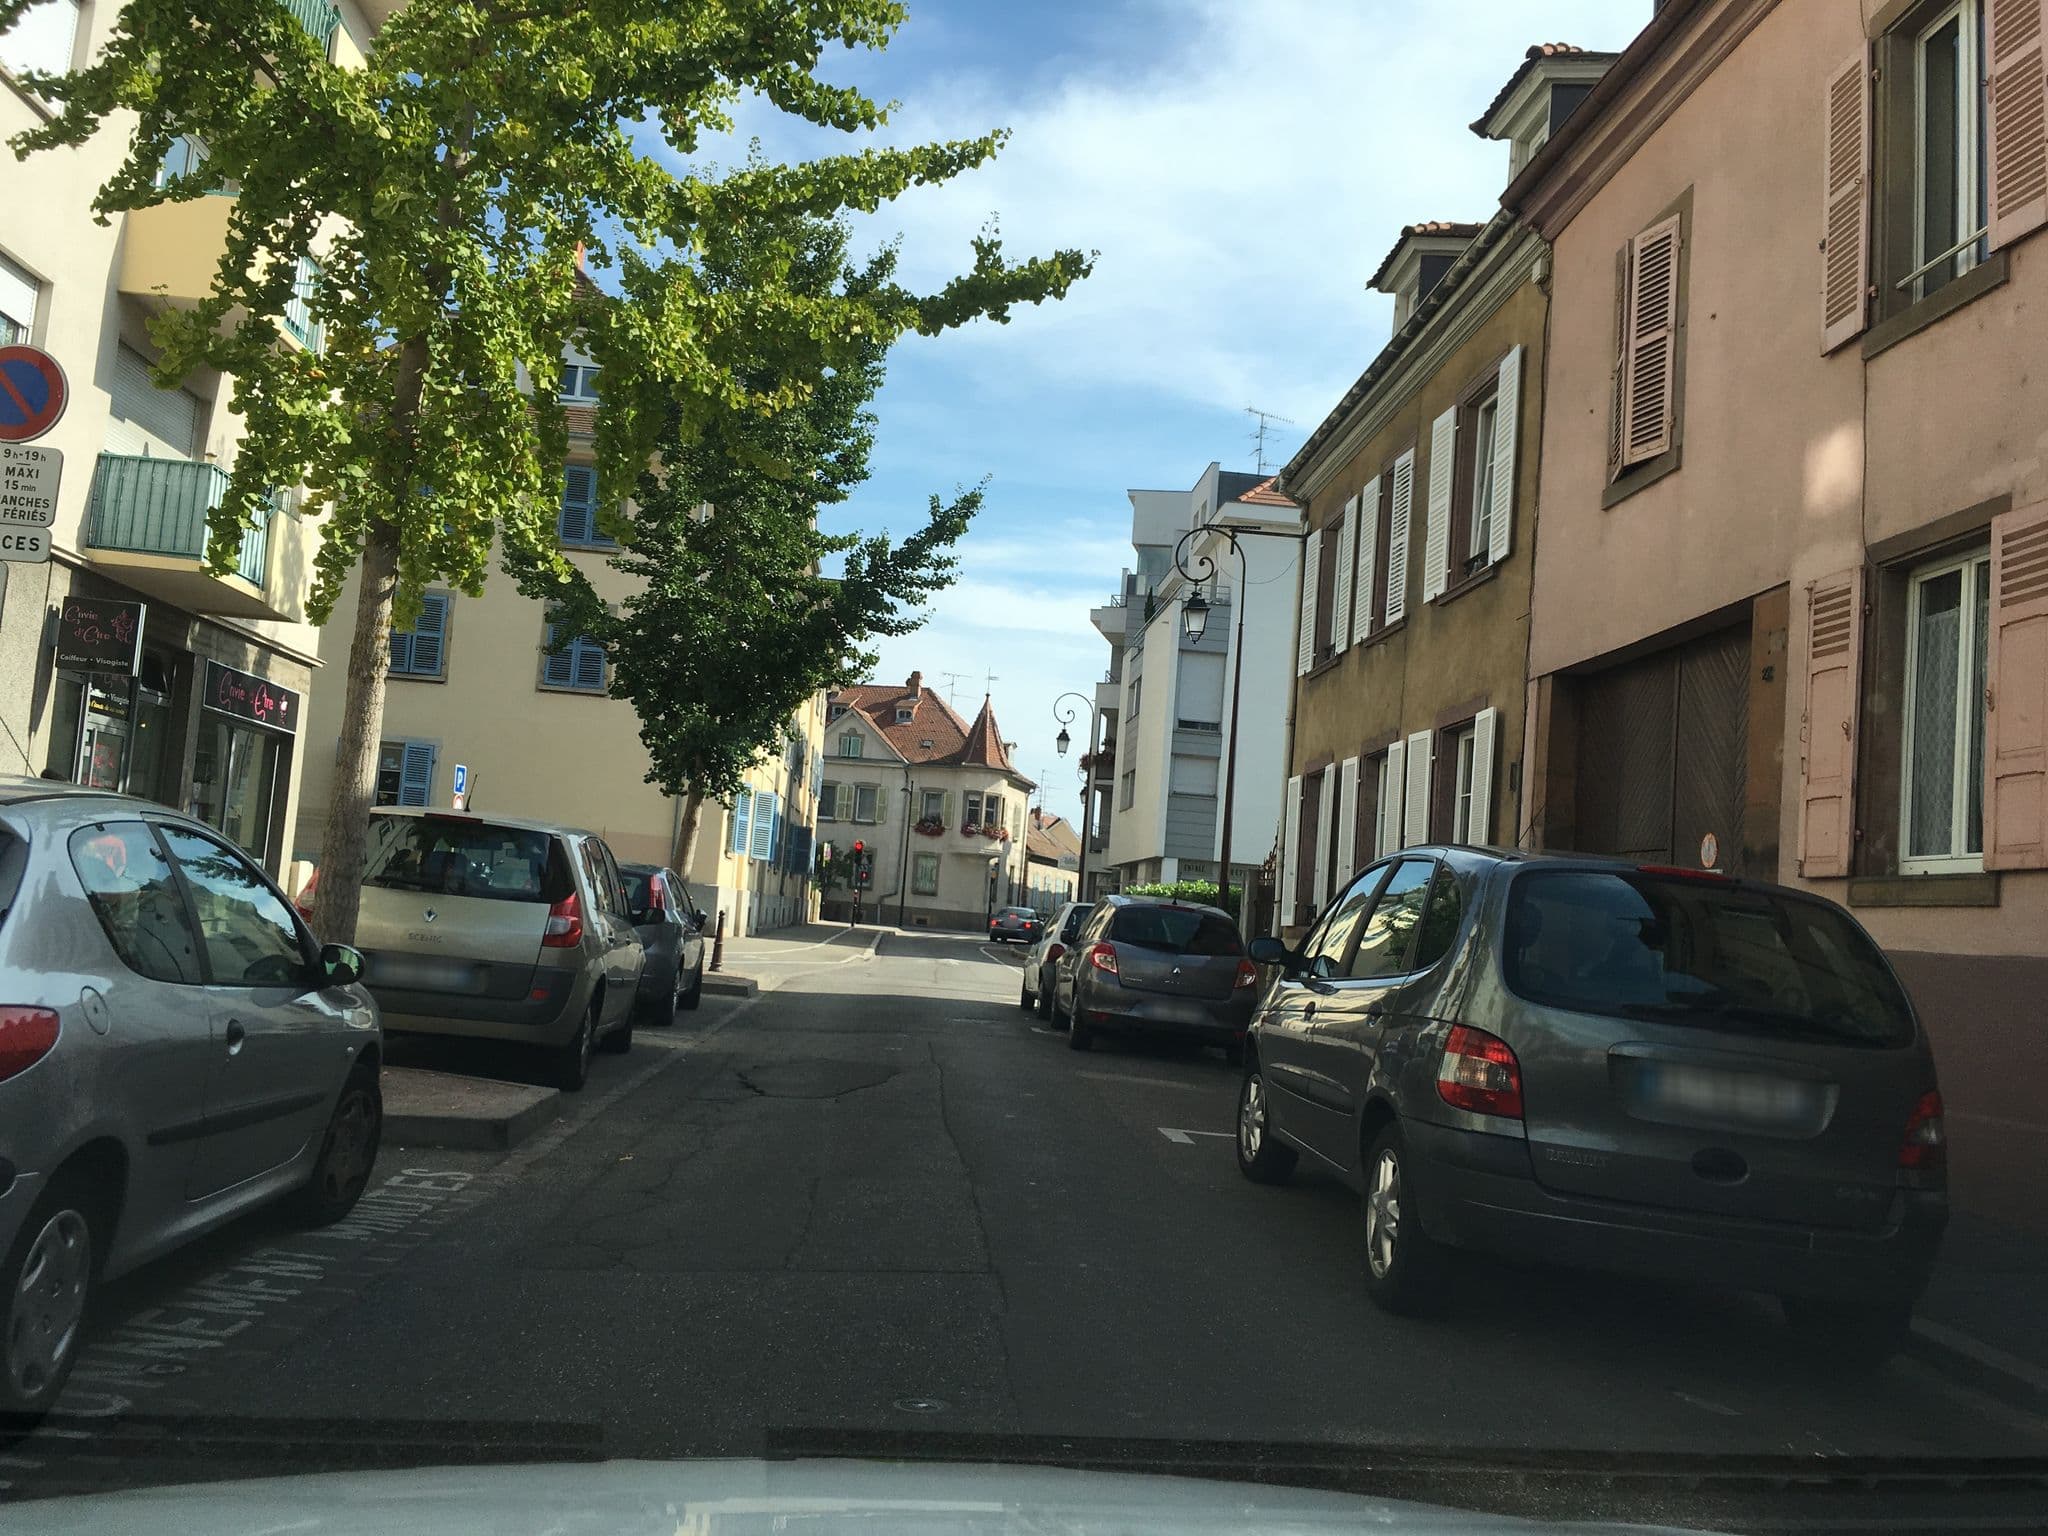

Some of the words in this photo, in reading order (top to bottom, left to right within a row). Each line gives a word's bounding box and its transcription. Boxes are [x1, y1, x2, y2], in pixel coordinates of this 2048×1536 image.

[5, 466, 39, 479] MAXI
[4, 480, 19, 490] 15
[21, 484, 36, 492] min
[3, 507, 47, 521] FÉRIÉS
[60, 653, 88, 662] Coiffeur
[96, 657, 129, 667] Visagiste
